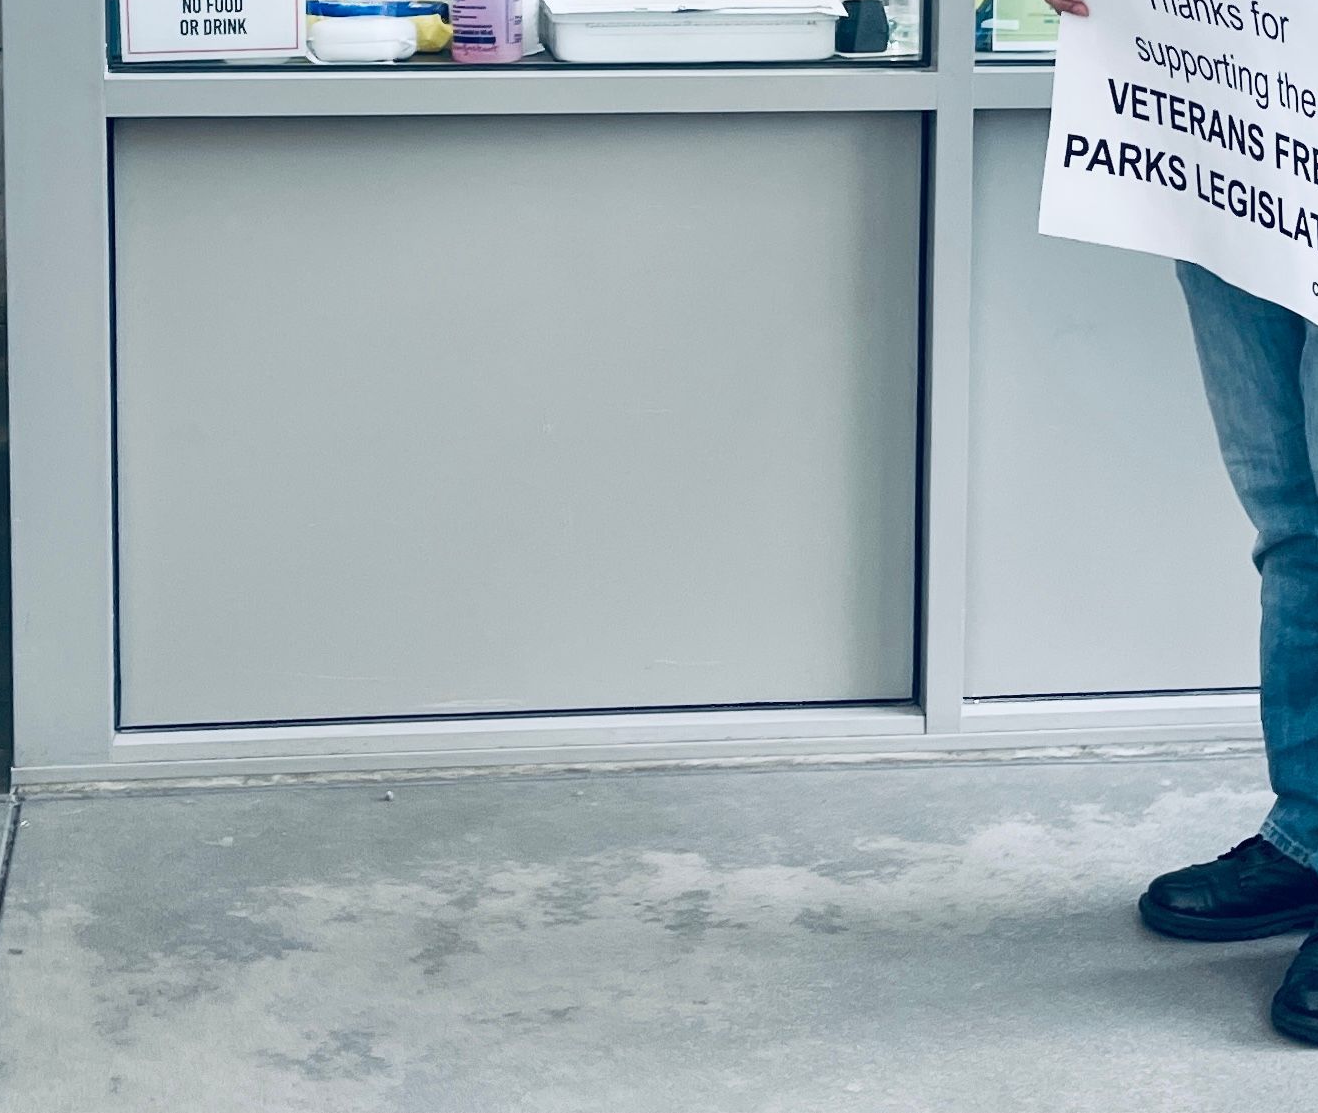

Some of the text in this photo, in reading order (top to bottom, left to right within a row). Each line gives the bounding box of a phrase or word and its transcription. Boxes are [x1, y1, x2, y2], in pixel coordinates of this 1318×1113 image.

[180, 18, 248, 36] OR DRINK
[1250, 0, 1290, 44] for
[1135, 35, 1317, 119] supporting the
[1108, 78, 1265, 162] VETERANS
[1063, 133, 1188, 192] PARKS
